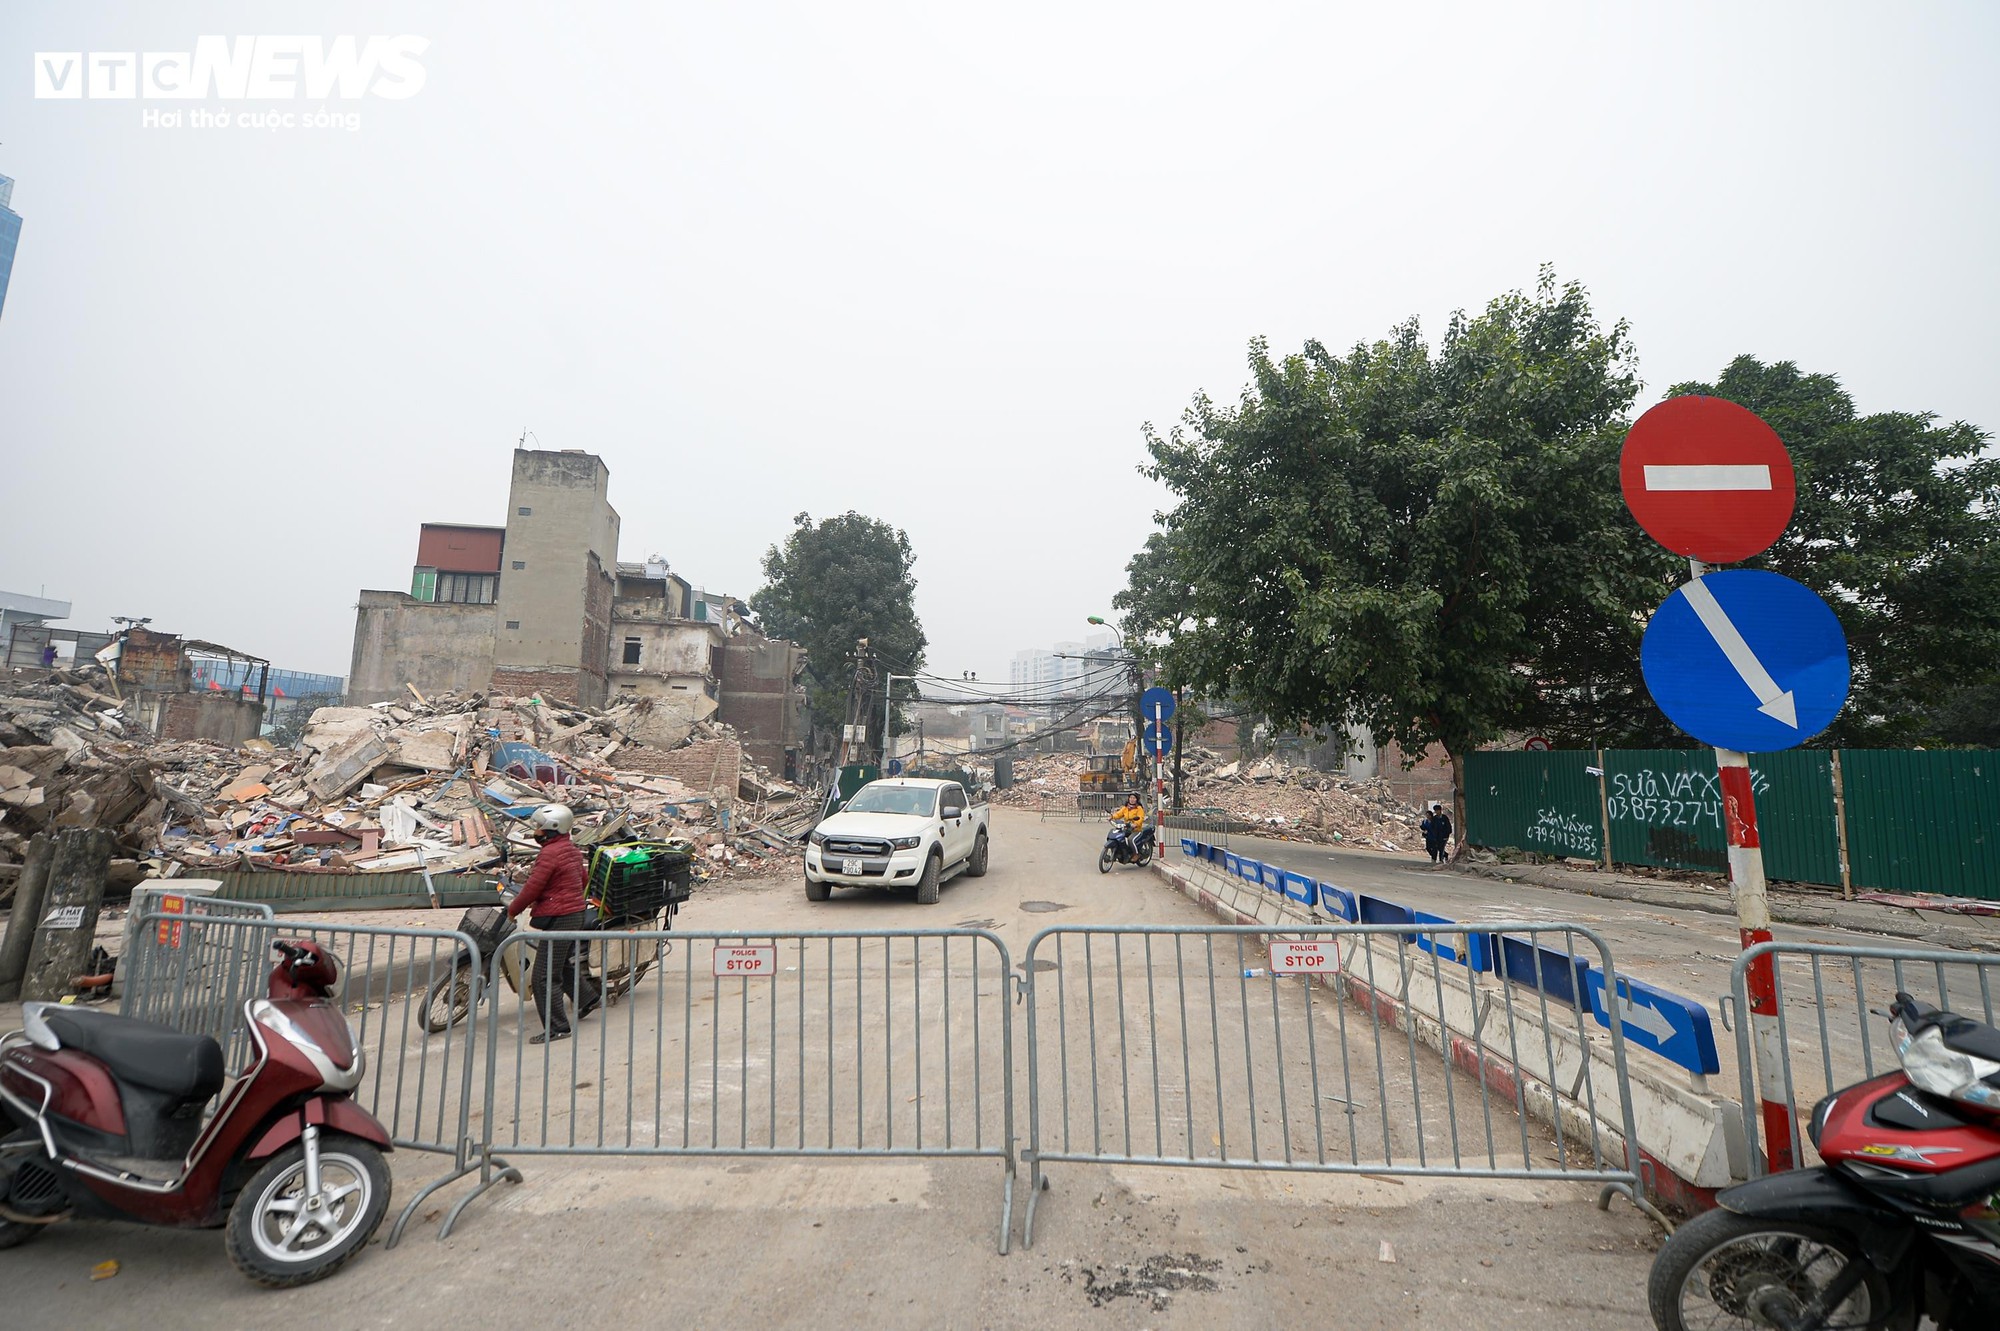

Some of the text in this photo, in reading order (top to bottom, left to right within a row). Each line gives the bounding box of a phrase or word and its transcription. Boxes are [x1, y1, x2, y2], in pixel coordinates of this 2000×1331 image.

[1698, 773, 1722, 800] X
[1607, 796, 1725, 829] 03853274
[1289, 944, 1319, 952] POLICE
[726, 959, 762, 970] STOP
[1285, 955, 1325, 967] STOP
